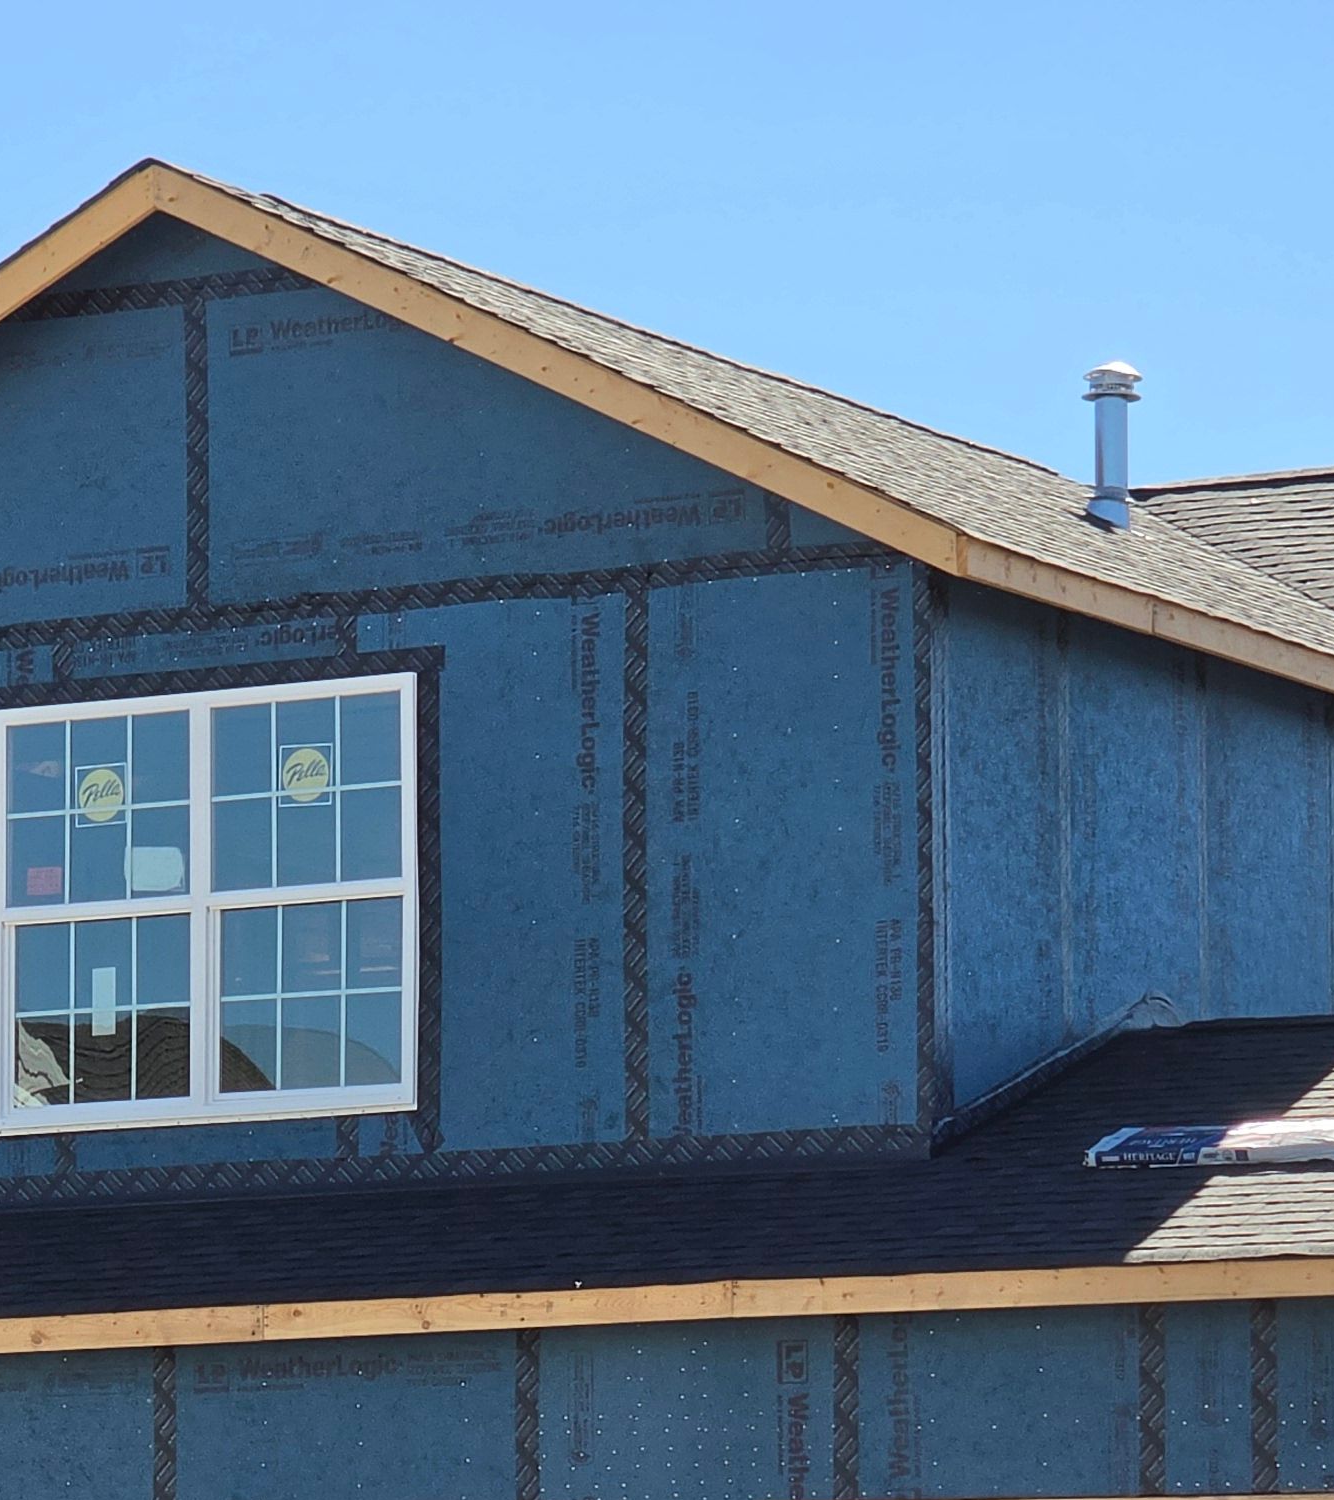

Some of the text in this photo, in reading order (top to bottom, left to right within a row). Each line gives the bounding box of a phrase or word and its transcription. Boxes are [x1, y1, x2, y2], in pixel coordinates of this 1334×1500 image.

[877, 586, 902, 768] WeatherLogic
[577, 612, 601, 791] WeatherLogic
[285, 759, 326, 783] Pella
[81, 778, 121, 806] Pella
[1123, 1152, 1175, 1161] HERITAGE
[240, 1352, 398, 1382] WeatherLogic
[786, 1344, 805, 1380] LP
